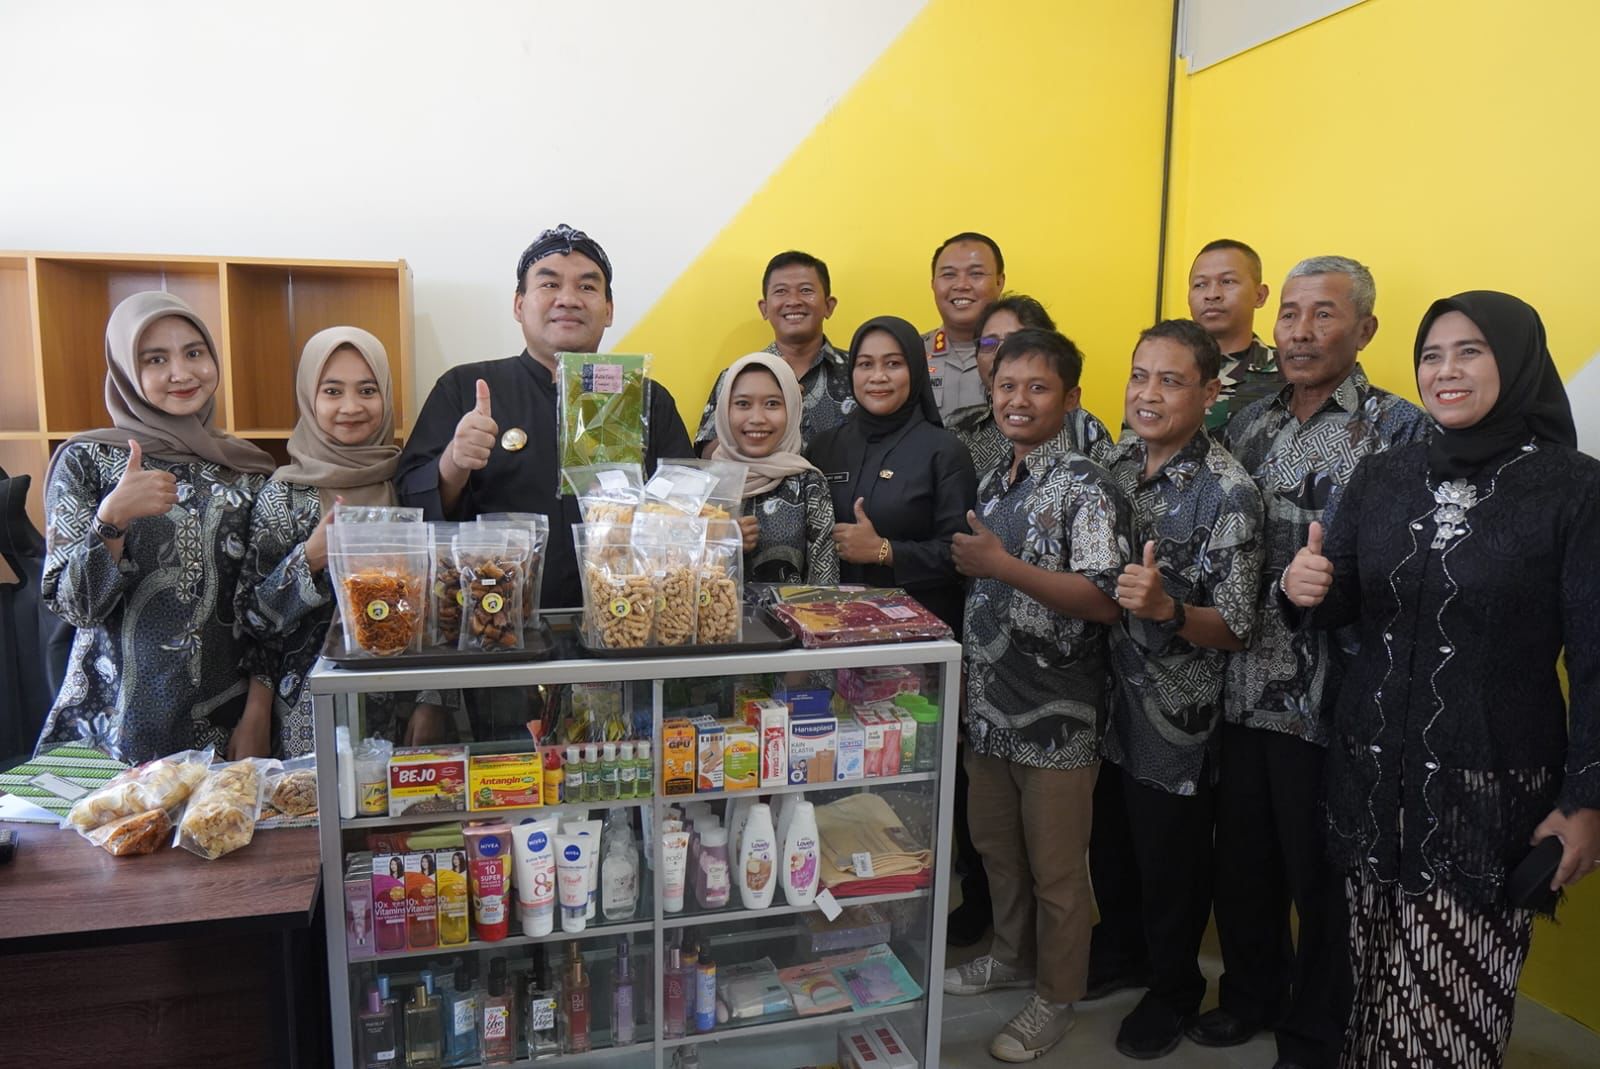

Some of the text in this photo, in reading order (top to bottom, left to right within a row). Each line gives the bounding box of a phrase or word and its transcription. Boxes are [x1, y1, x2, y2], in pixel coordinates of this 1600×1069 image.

[794, 724, 834, 734] Hansaplast
[668, 740, 691, 749] GPU
[399, 768, 436, 783] BEJO
[479, 776, 521, 786] Antangin
[528, 838, 545, 846] NIVEA
[751, 841, 770, 849] Lovely
[796, 840, 815, 848] Lovely
[485, 865, 497, 875] 10
[480, 874, 500, 882] SUPER
[534, 872, 548, 897] 8
